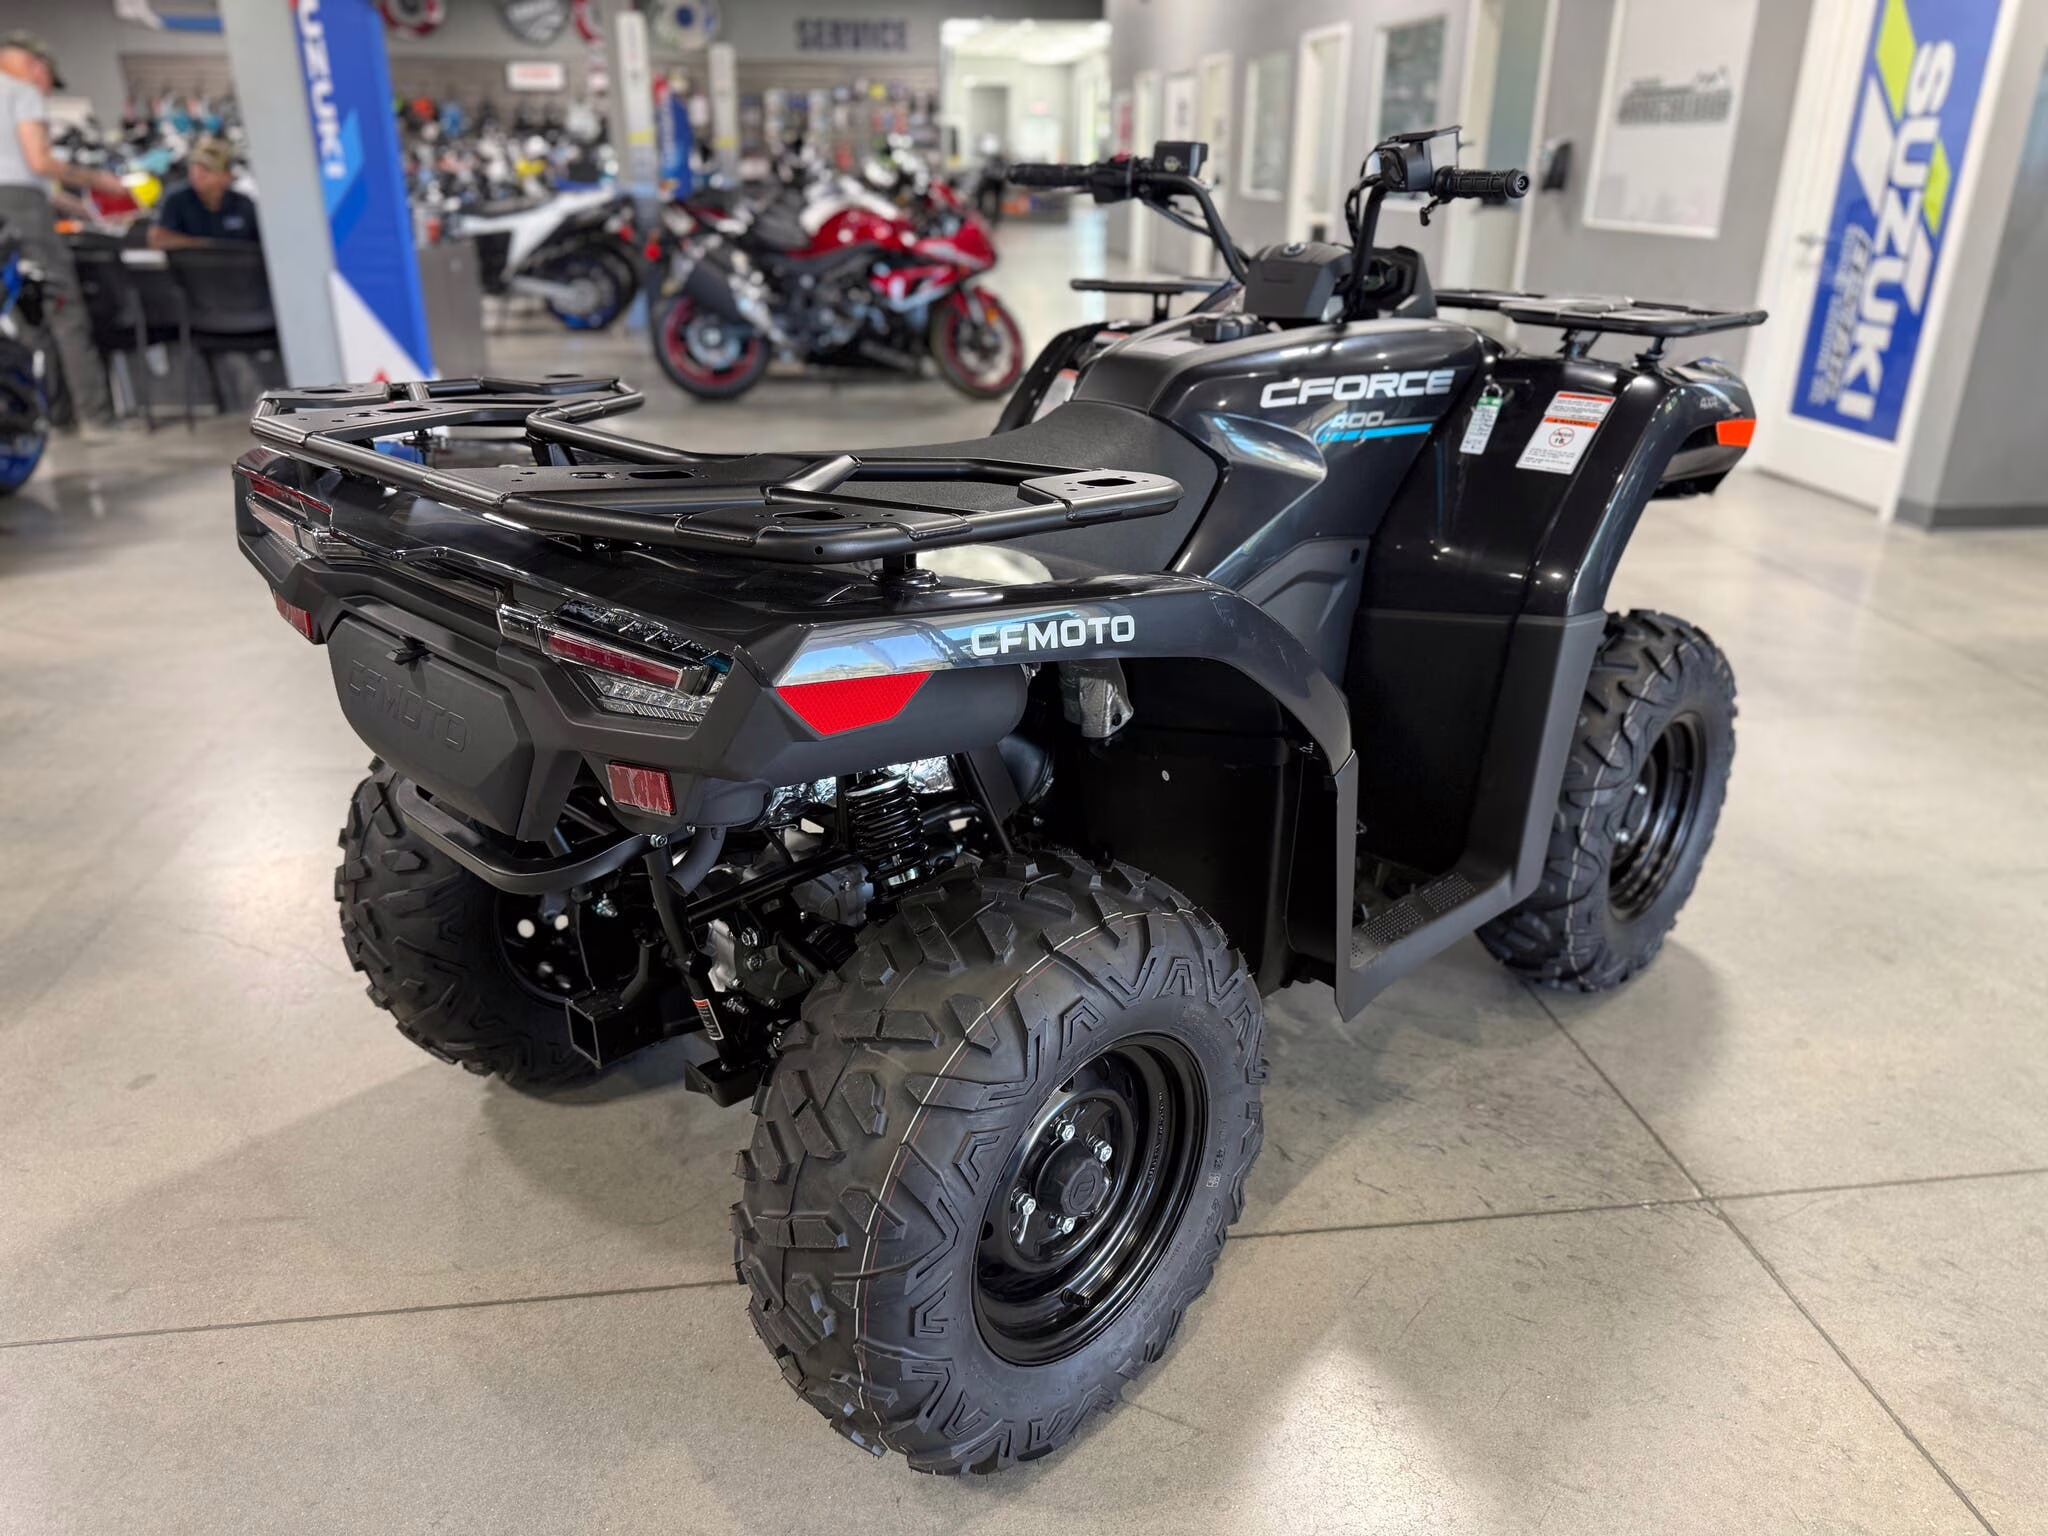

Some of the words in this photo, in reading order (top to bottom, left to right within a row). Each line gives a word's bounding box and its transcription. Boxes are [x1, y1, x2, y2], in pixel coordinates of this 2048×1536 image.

[797, 17, 910, 52] SERVICE
[1837, 40, 1954, 421] SUZUKI
[1260, 370, 1455, 408] CFORCE
[1330, 411, 1385, 429] 400
[970, 615, 1135, 656] CFMOTO
[348, 660, 472, 753] CFMOTO
